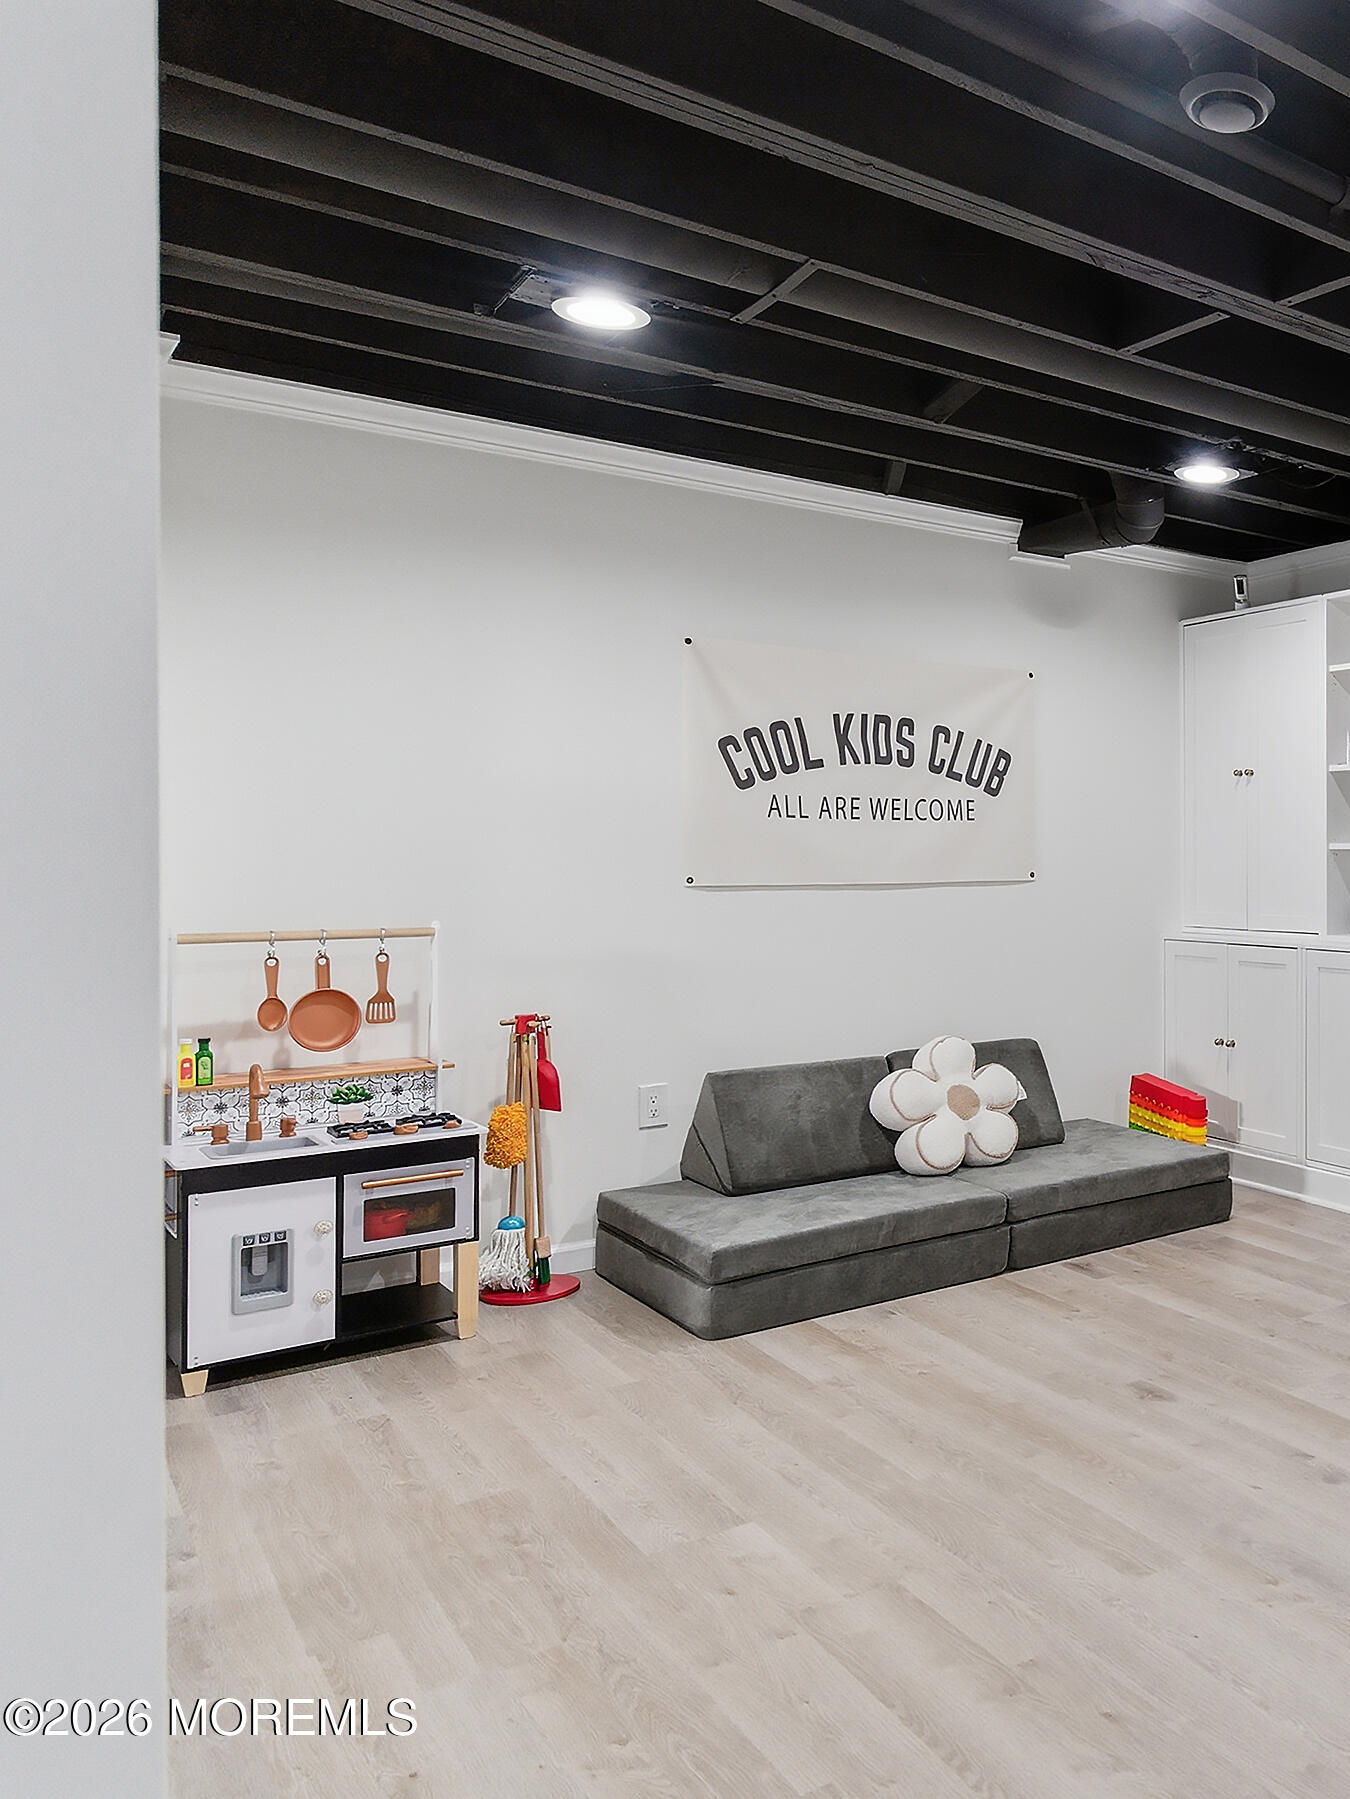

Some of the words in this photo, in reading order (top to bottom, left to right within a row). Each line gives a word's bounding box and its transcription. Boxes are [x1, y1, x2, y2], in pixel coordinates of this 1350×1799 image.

[717, 716, 825, 791] COOL
[832, 712, 915, 769] KIDS
[928, 724, 1012, 798] CLUB
[767, 794, 810, 819] ALL
[818, 796, 861, 820] ARE
[868, 797, 976, 822] WELCOME
